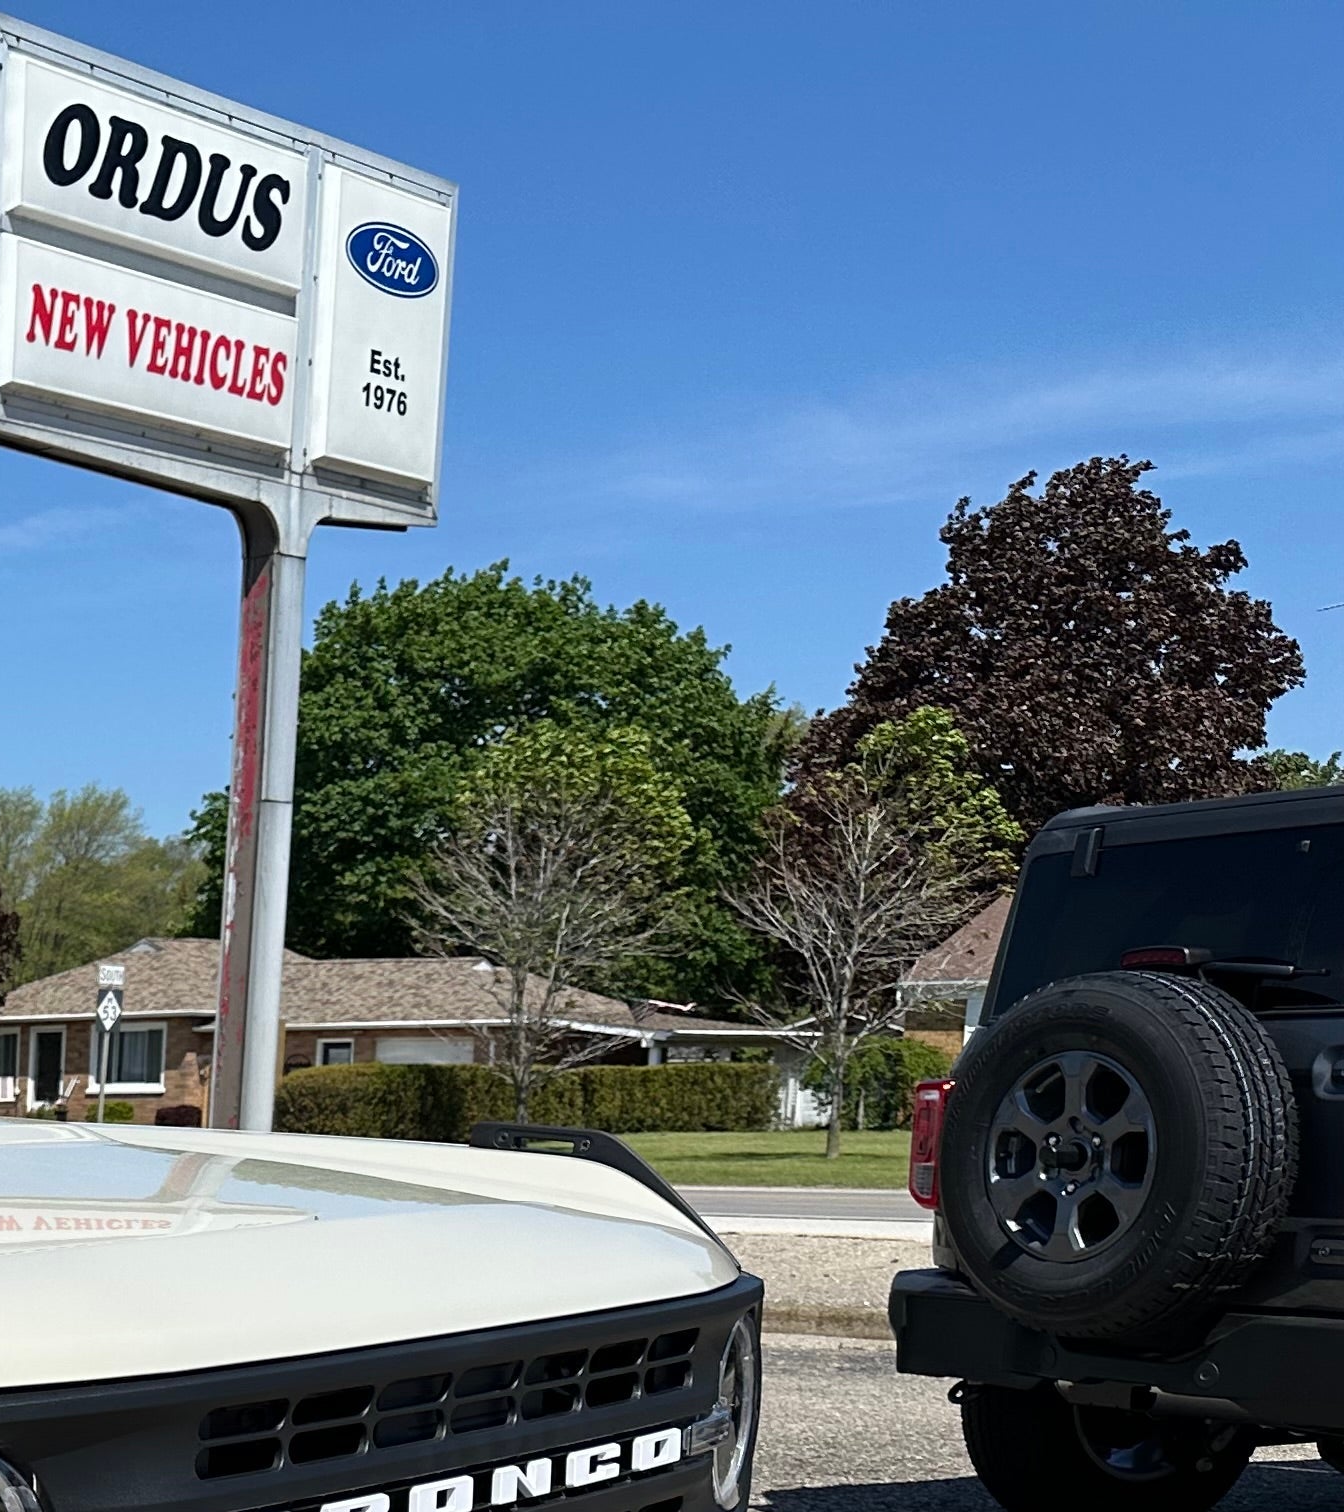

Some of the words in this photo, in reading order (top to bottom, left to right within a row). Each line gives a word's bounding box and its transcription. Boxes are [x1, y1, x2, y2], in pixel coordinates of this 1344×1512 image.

[43, 103, 291, 252] ORDUS
[366, 231, 422, 285] Ford
[26, 283, 116, 361] NEW
[126, 308, 288, 406] VEHICLES
[370, 349, 406, 382] Est.
[362, 381, 408, 416] 1976
[102, 1005, 117, 1021] 53
